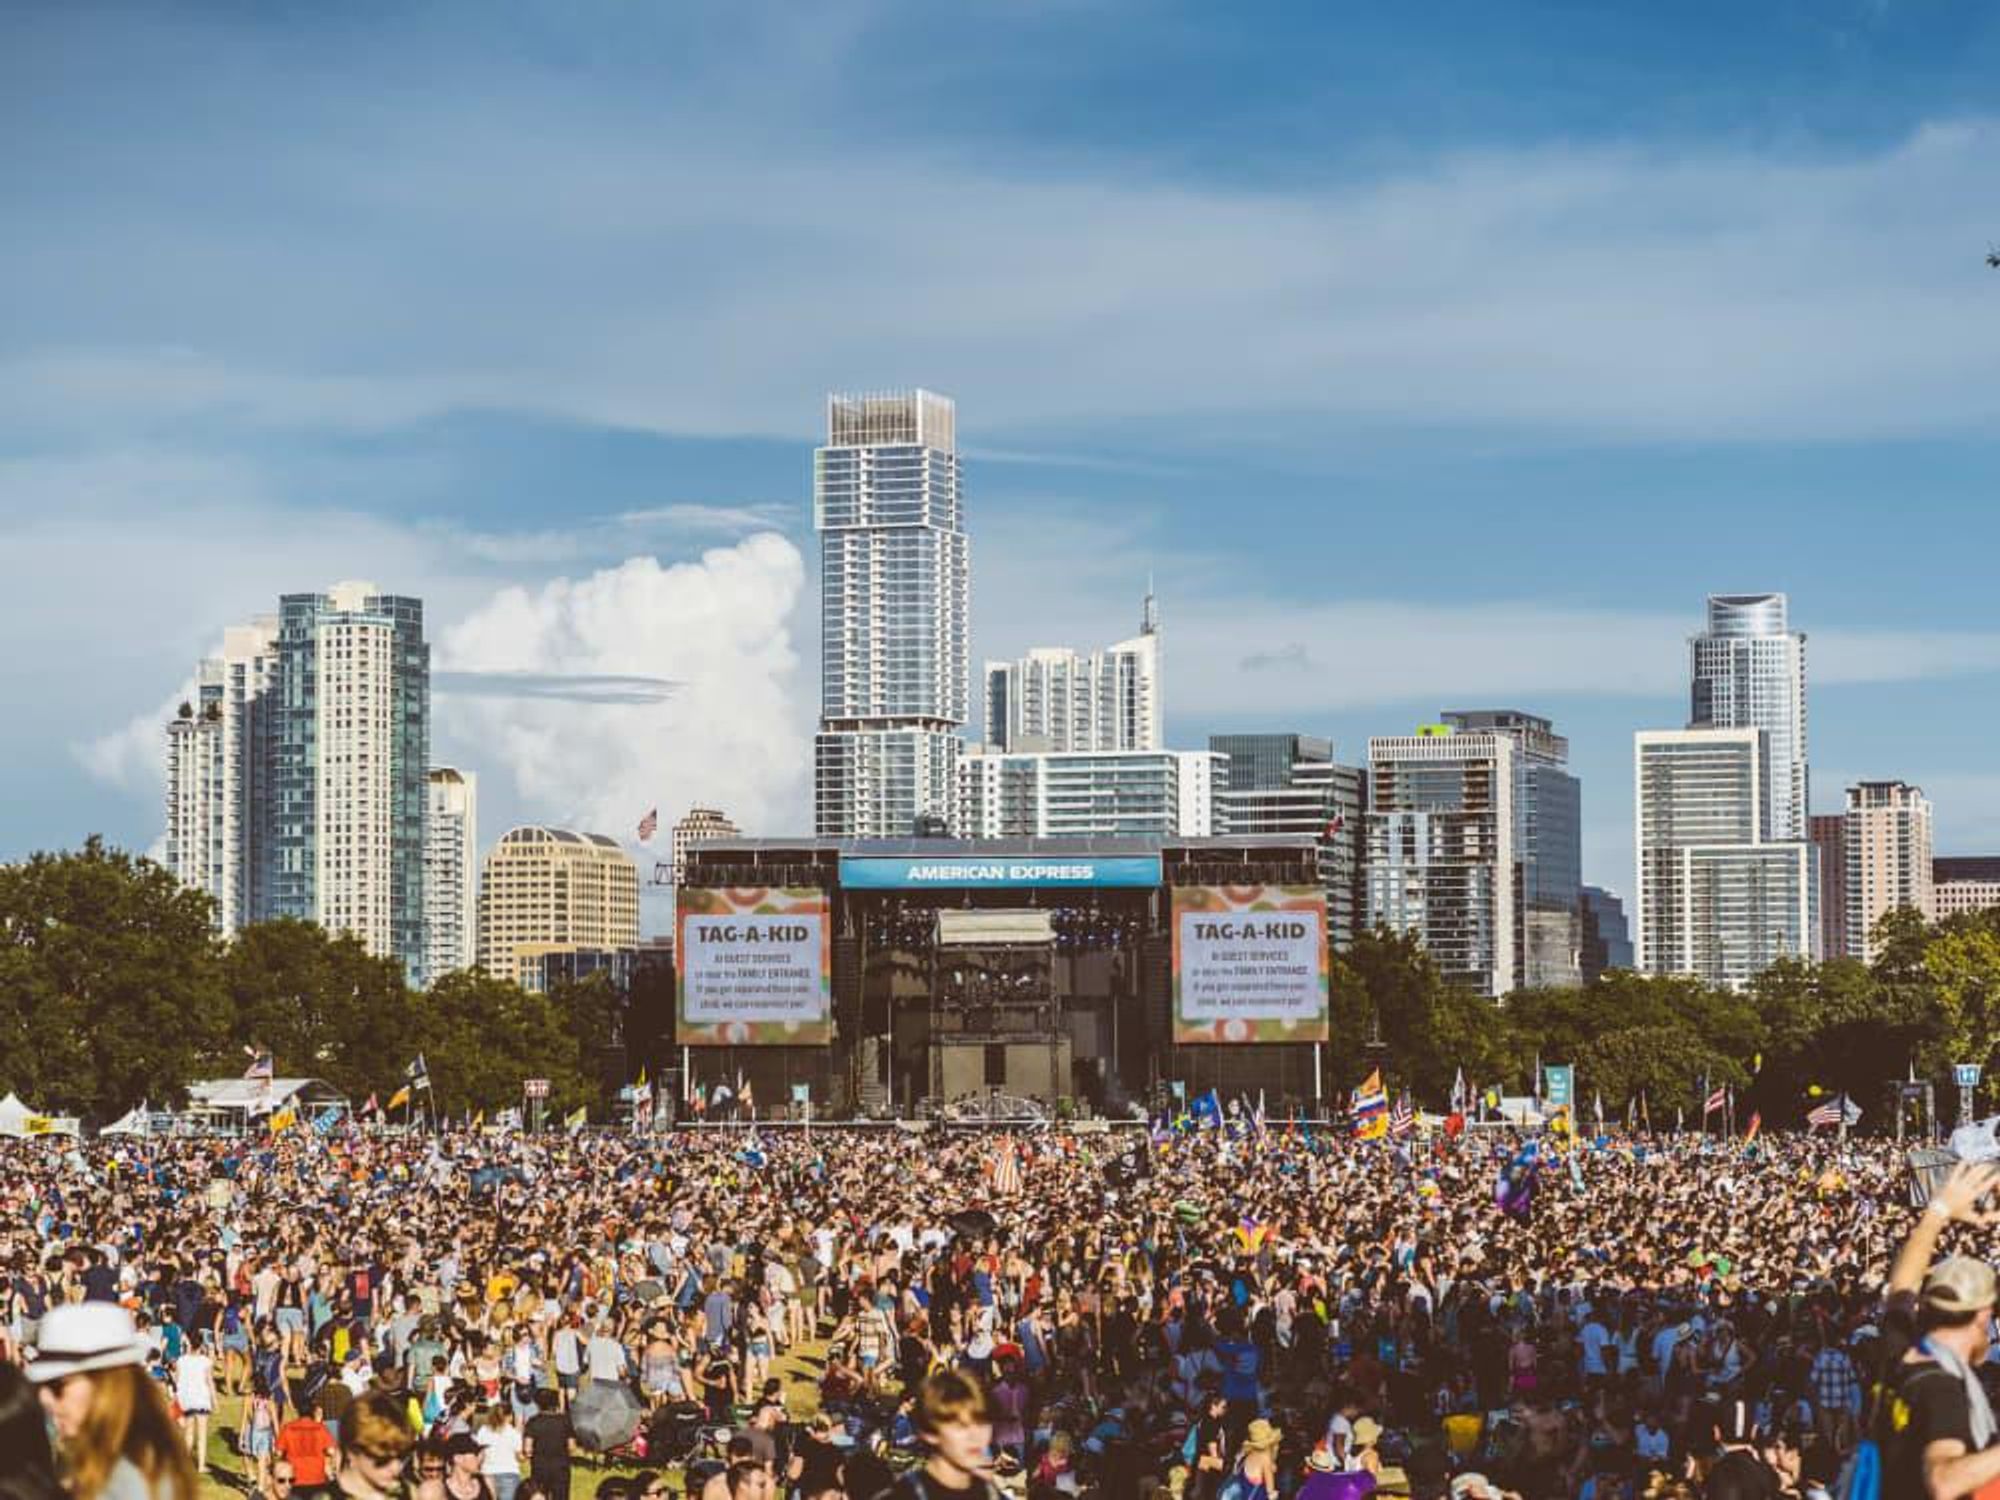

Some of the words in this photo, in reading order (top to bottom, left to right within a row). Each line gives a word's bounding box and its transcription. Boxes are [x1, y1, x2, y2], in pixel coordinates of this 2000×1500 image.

[907, 865, 1004, 880] AMERICAN
[1010, 865, 1094, 880] EXPRESS
[697, 926, 808, 943] TAG-A-KID
[1194, 923, 1306, 940] TAG-A-KID
